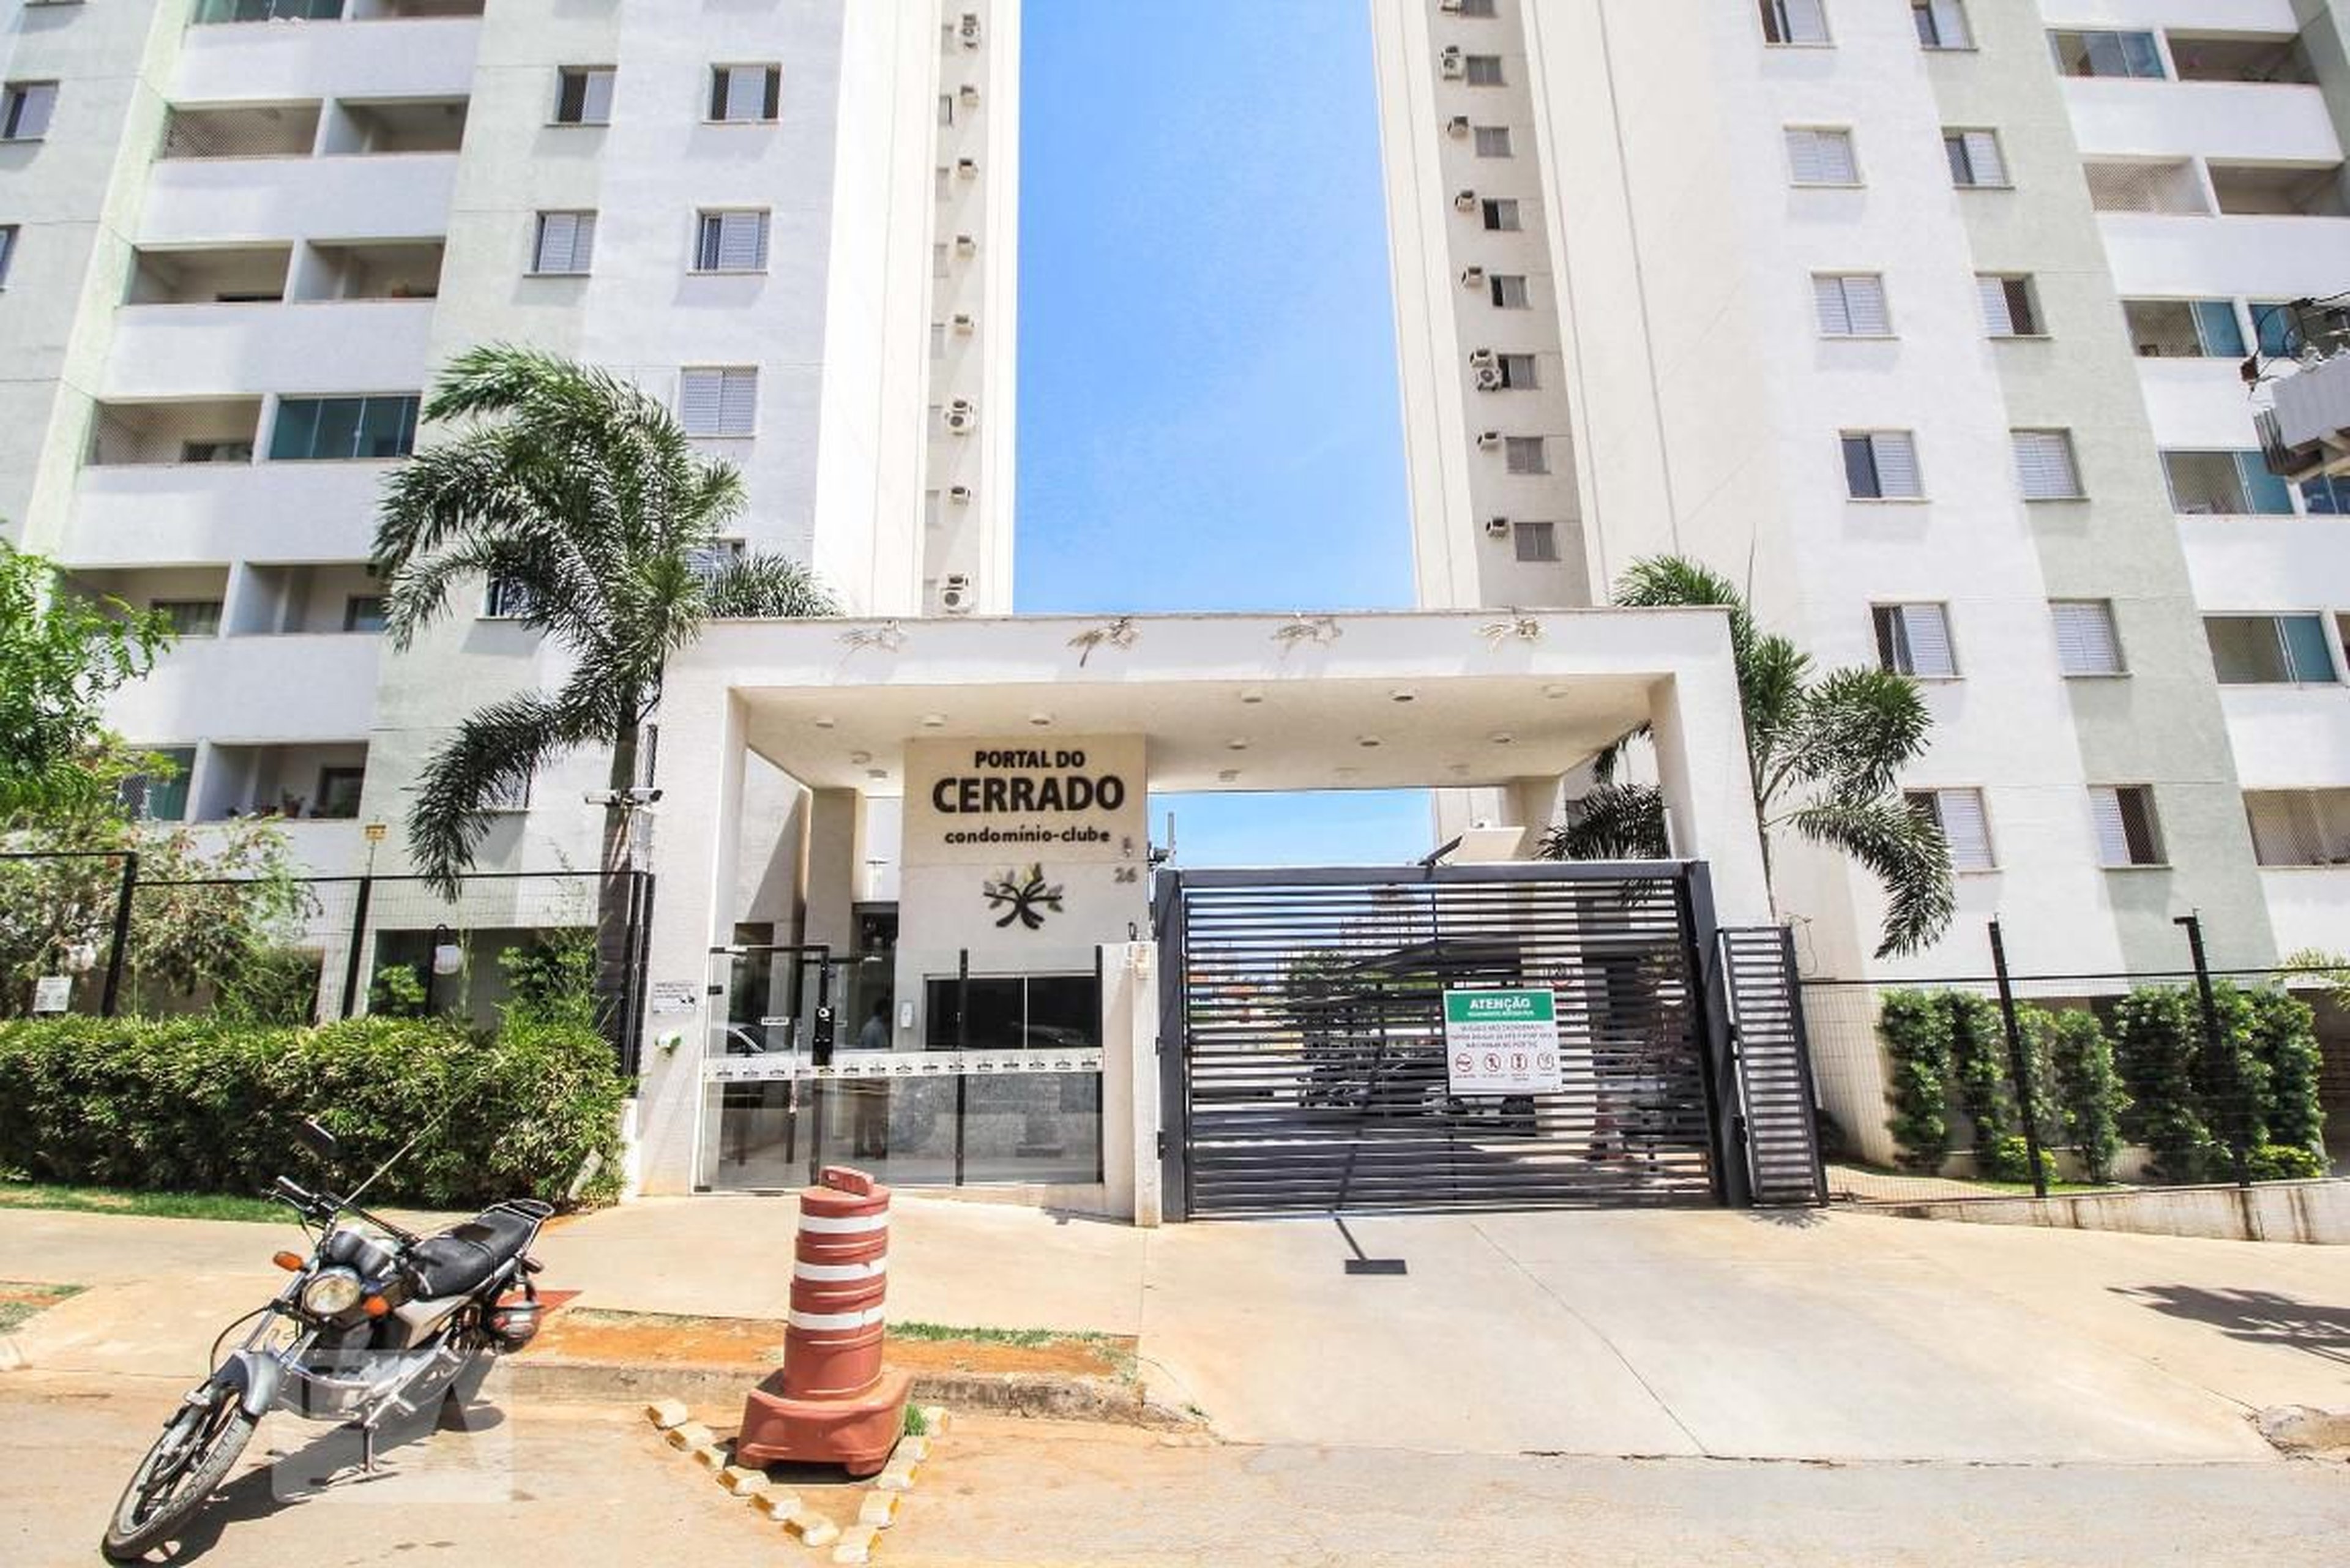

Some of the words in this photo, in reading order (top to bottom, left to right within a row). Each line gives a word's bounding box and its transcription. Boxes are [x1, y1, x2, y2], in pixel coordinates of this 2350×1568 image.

[974, 749, 1052, 769] PORTAL
[1055, 749, 1086, 769] DO
[932, 774, 1125, 813] CERRADO
[944, 824, 1111, 845] condomínio-clube
[1469, 996, 1531, 1011] ATENÇÃO
